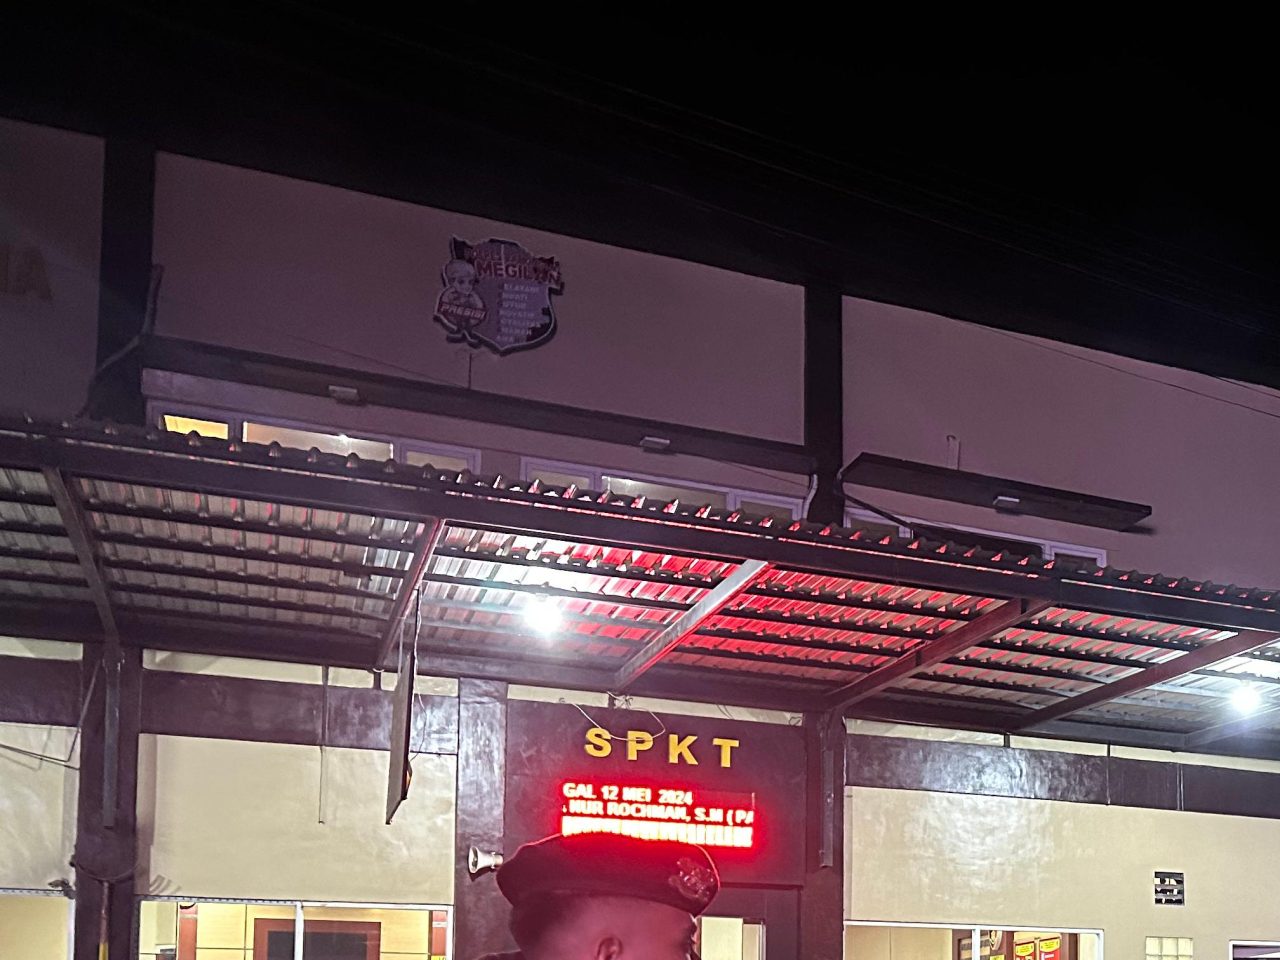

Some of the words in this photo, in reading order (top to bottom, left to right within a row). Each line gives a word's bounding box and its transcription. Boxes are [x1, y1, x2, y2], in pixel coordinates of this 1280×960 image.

[584, 727, 740, 768] SPKT
[602, 785, 619, 800] 12
[622, 787, 651, 802] MEI
[658, 789, 693, 805] 2024
[569, 800, 603, 815] NUR
